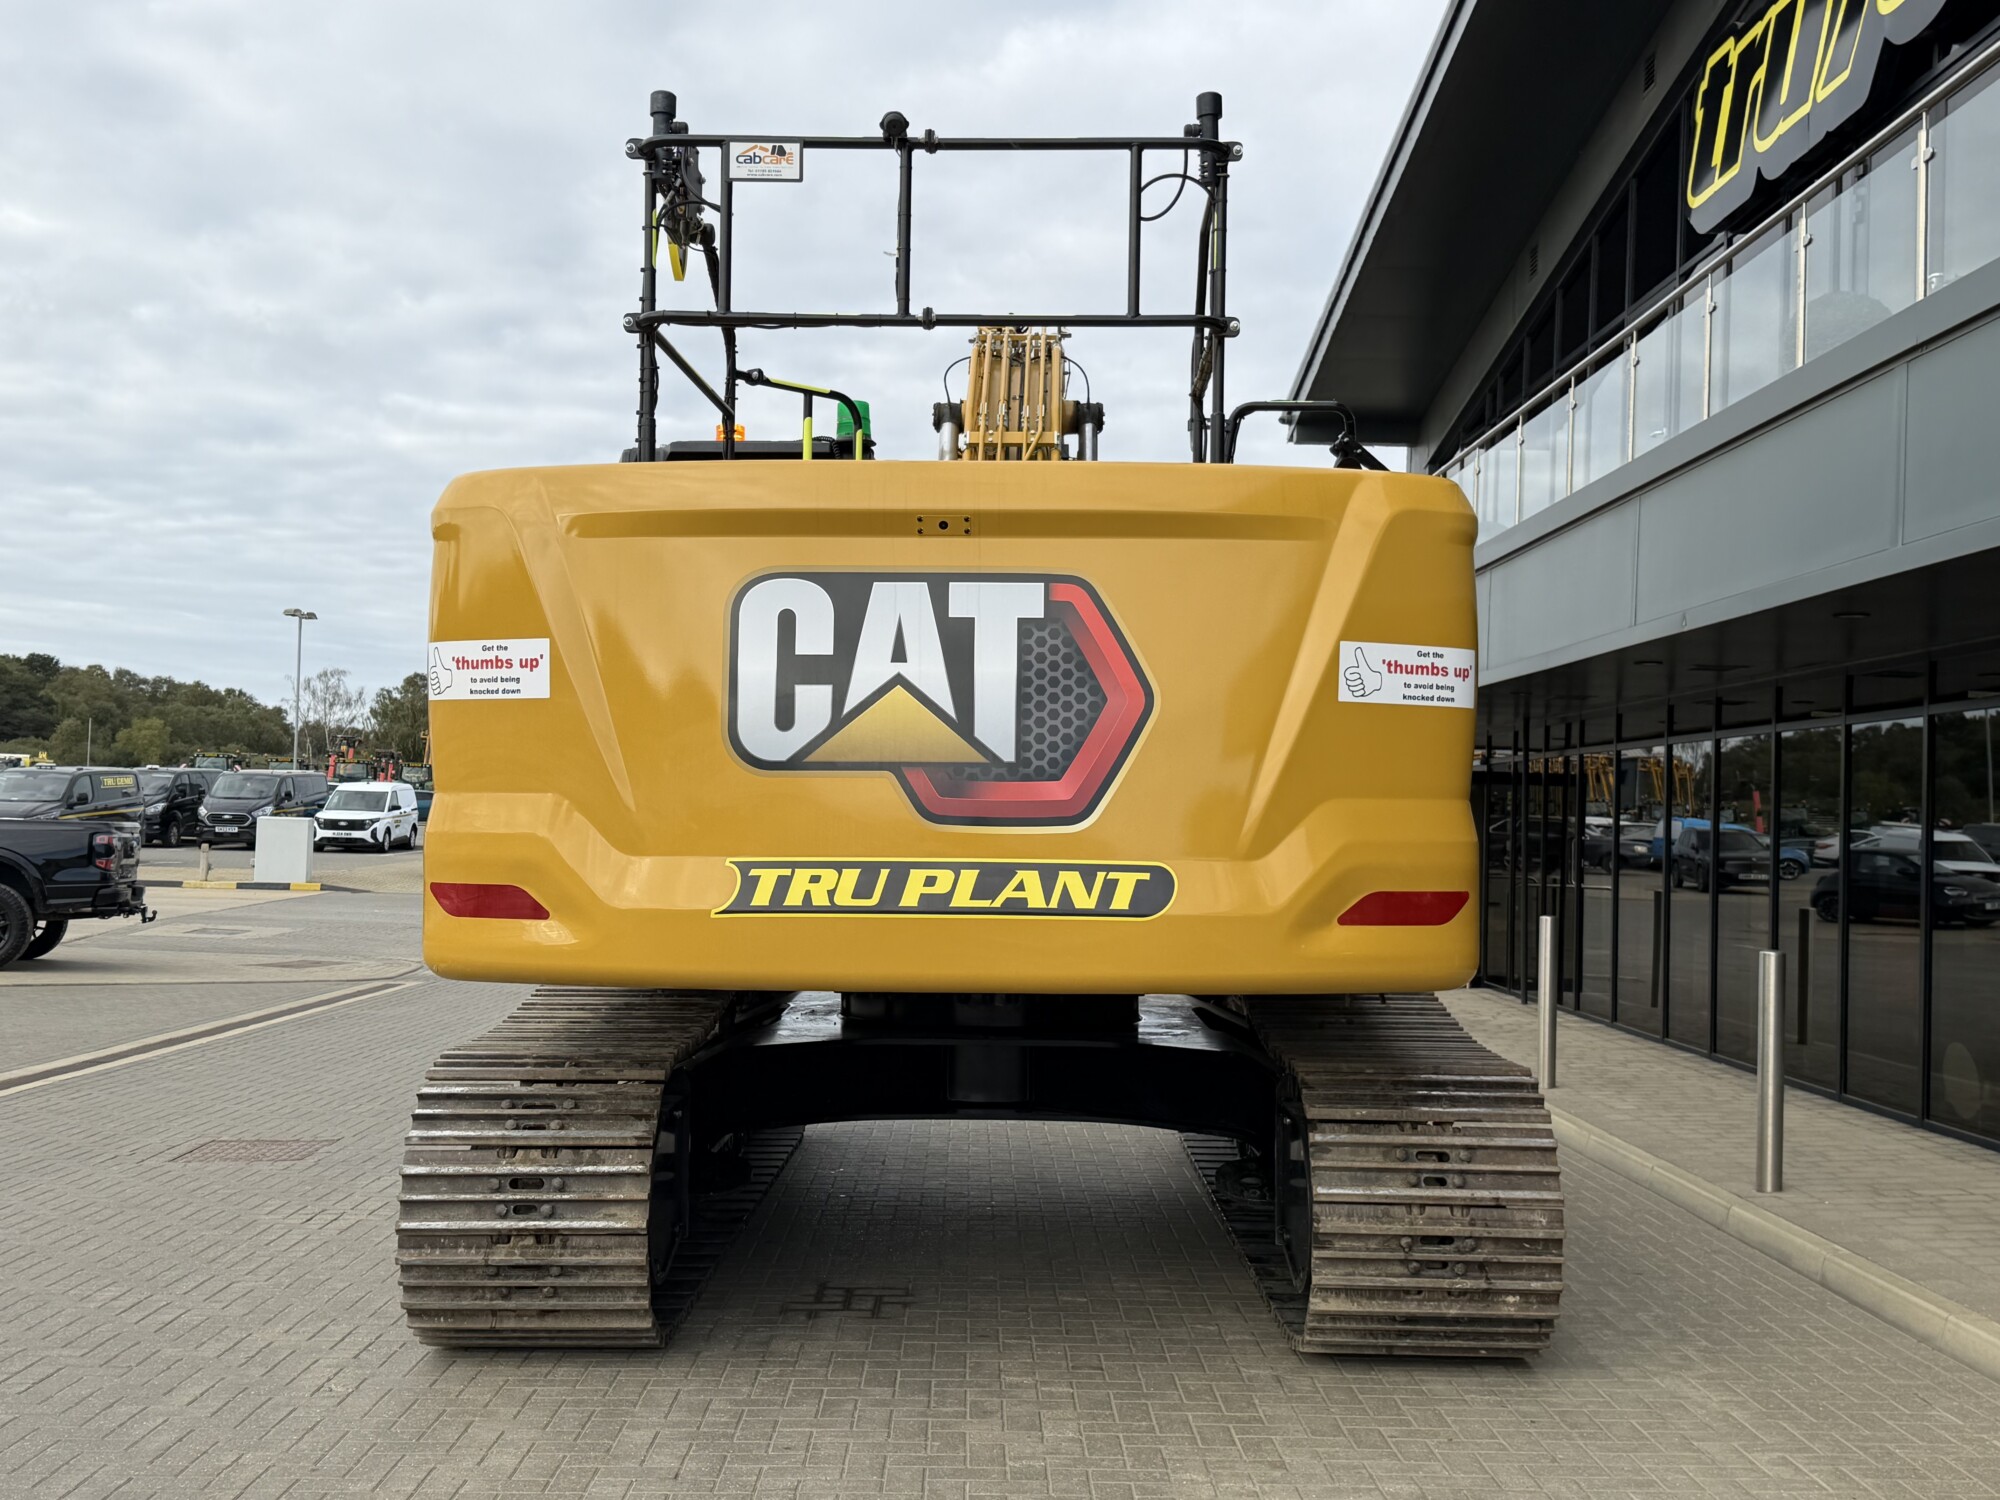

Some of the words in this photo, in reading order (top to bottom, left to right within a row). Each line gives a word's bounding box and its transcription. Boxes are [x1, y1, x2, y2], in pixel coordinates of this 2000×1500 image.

[481, 644, 494, 652] Get
[496, 644, 508, 652] the
[1417, 650, 1430, 659] Get
[1432, 651, 1444, 659] the
[452, 655, 514, 670] 'thumbs
[737, 577, 1045, 762] CAT
[1382, 659, 1449, 677] 'thumbs
[500, 676, 520, 684] being
[1413, 682, 1434, 690] avoid
[1435, 683, 1455, 692] being
[1402, 693, 1435, 702] knocked
[1436, 695, 1455, 703] down
[748, 868, 891, 907] TRU
[898, 868, 1151, 910] PLANT
